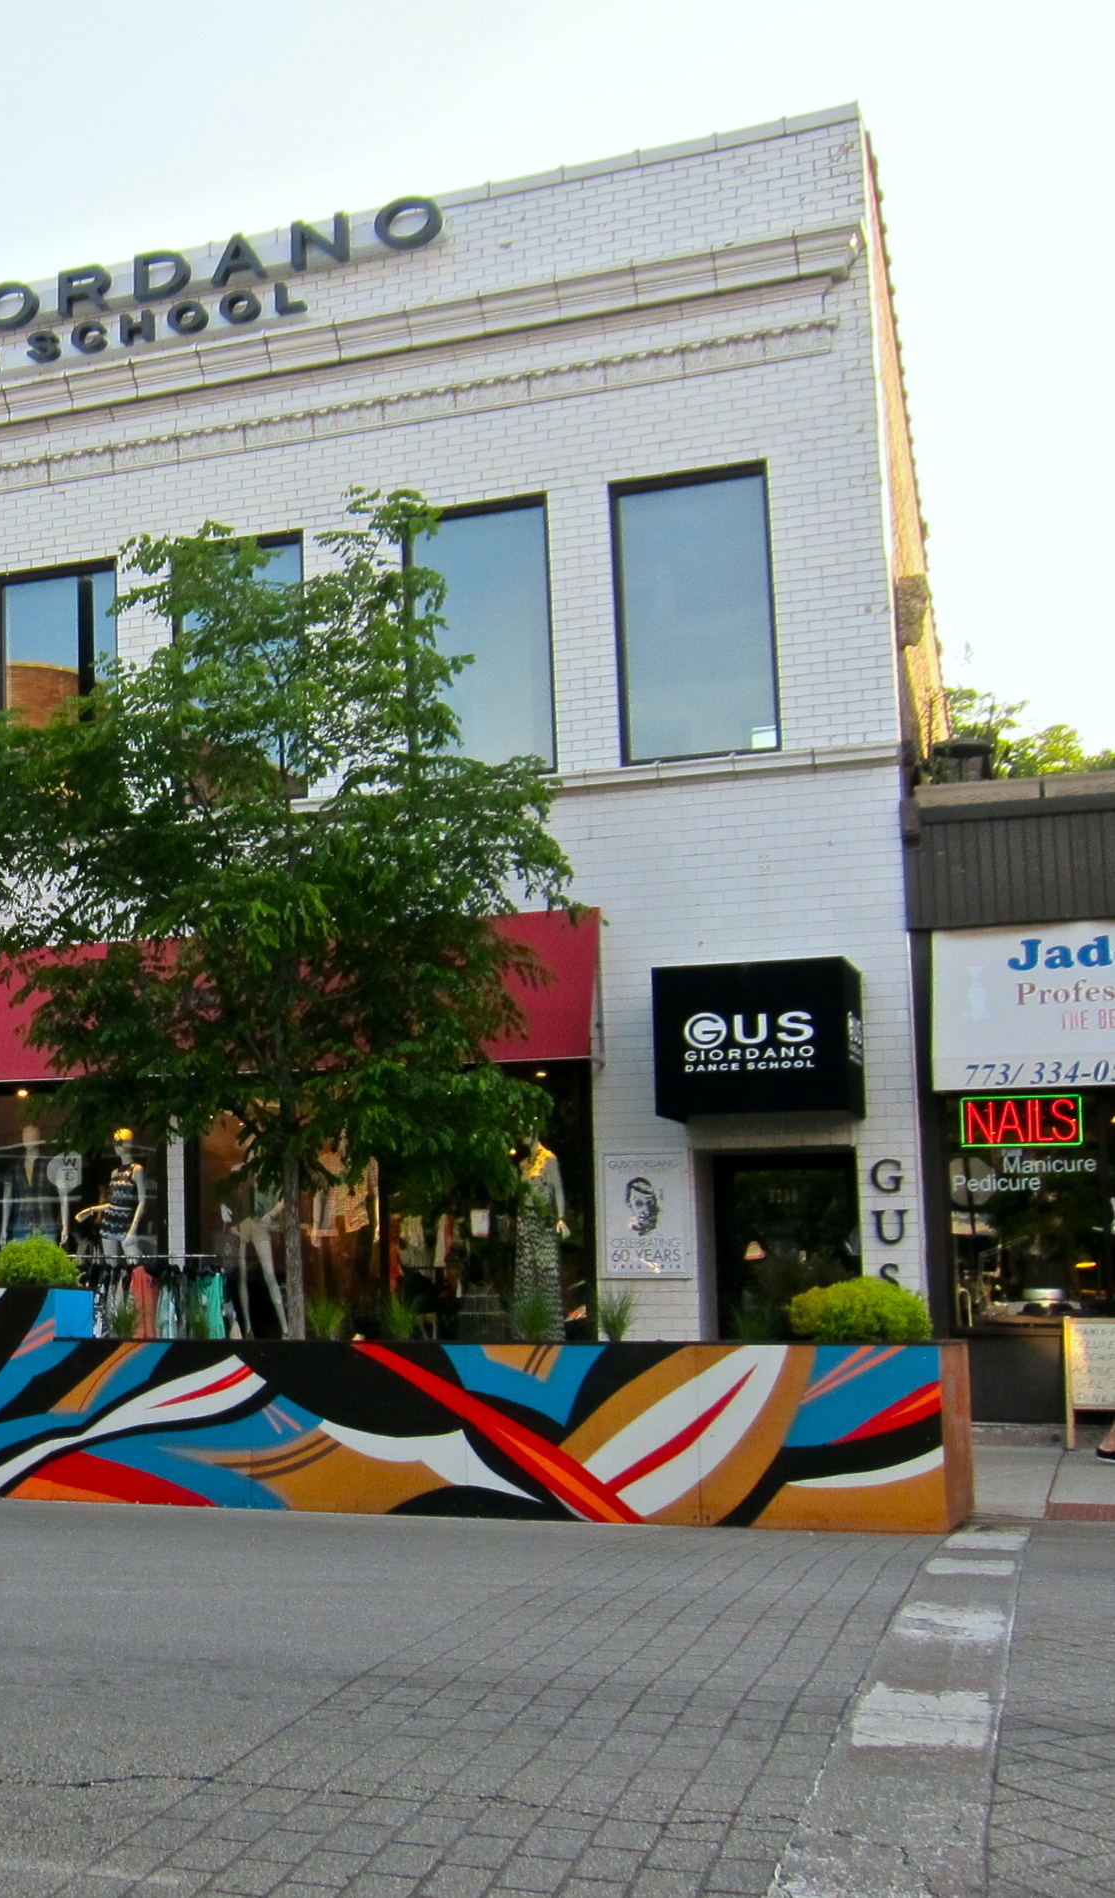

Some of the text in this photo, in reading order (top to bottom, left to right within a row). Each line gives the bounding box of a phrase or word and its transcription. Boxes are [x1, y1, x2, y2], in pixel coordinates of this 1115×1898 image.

[26, 281, 308, 364] SCHOOL
[1007, 935, 1115, 971] Jad
[684, 1011, 815, 1049] GUS
[684, 1045, 815, 1062] GIORDANO
[685, 1060, 815, 1073] DANCE SCHOOL
[965, 1059, 1115, 1087] 773/ 334-0
[966, 1098, 1078, 1144] NAILS
[1002, 1156, 1097, 1174] Manicure
[952, 1174, 1041, 1193] Pedicure
[611, 1238, 681, 1249] CELEBRATING
[611, 1248, 682, 1262] 60 YEARS
